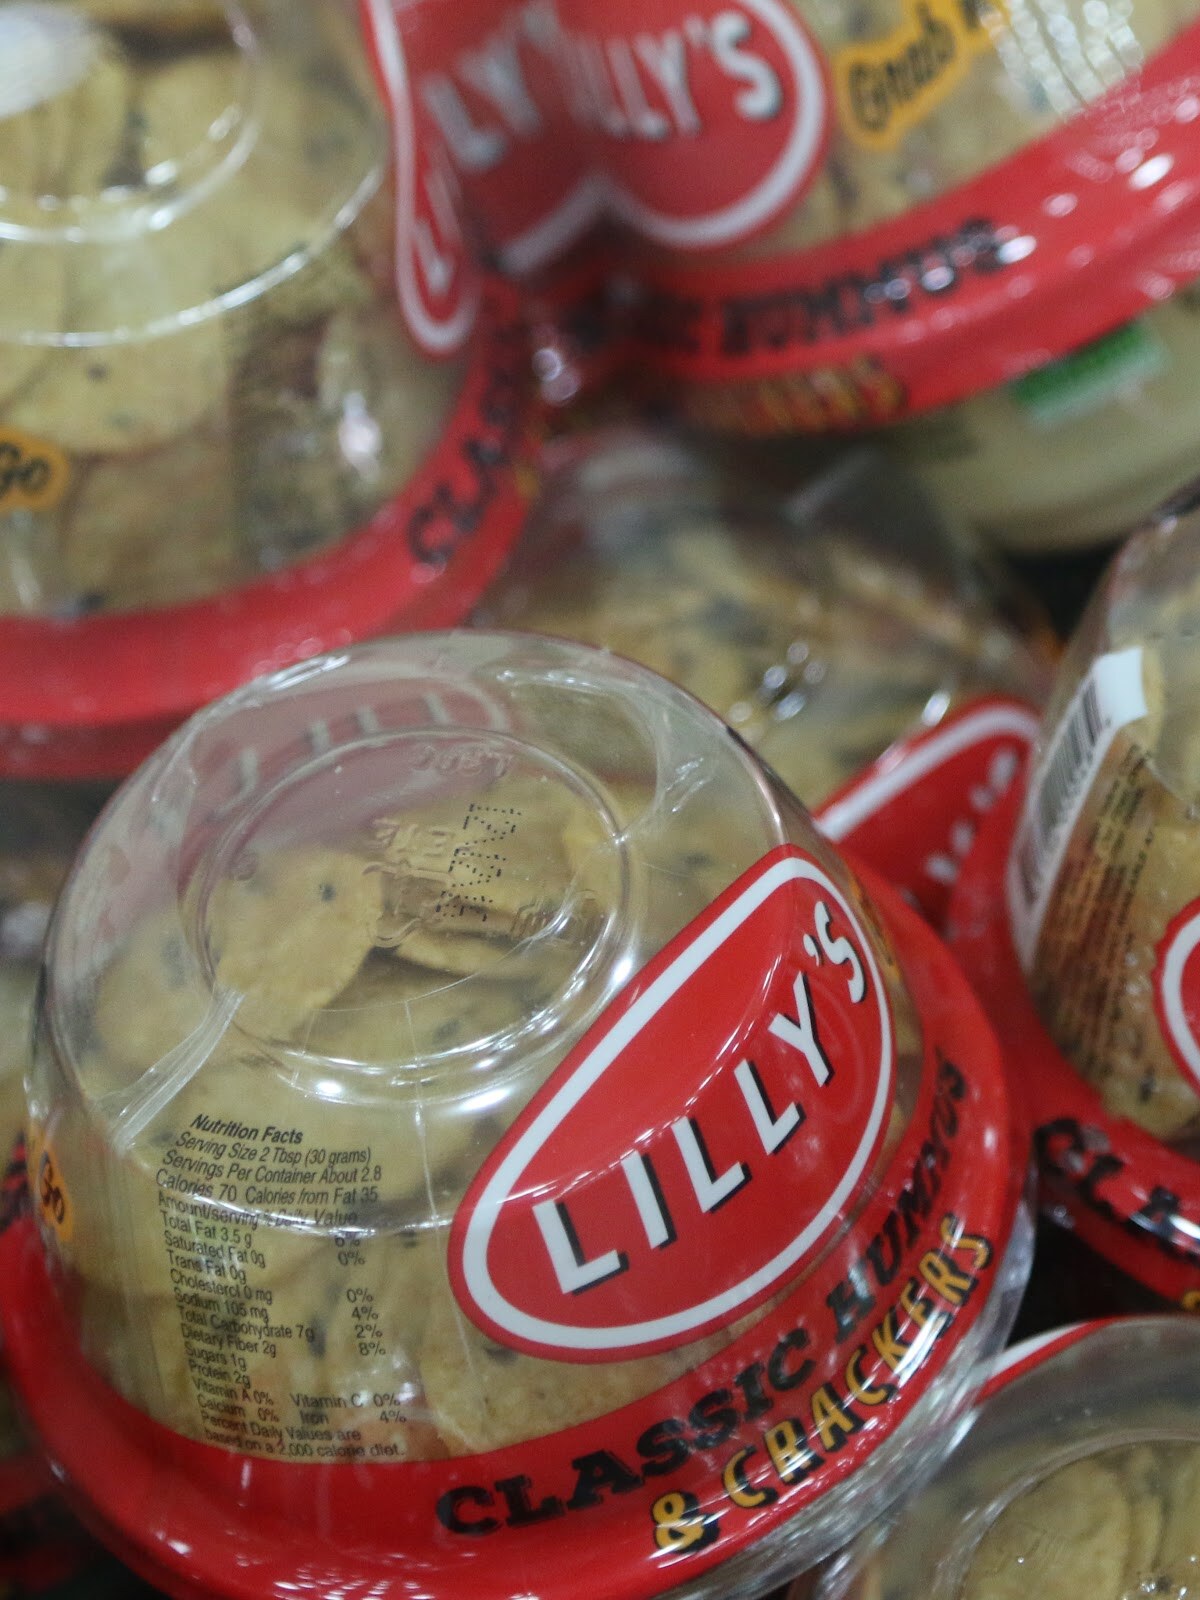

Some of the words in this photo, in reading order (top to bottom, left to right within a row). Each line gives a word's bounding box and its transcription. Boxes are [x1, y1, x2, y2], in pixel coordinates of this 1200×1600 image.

[532, 899, 868, 1297] LILLY'S
[190, 1114, 258, 1140] Nutrition
[262, 1126, 303, 1144] Facts
[176, 1131, 226, 1160] Serving
[228, 1143, 257, 1161] Size
[258, 1149, 270, 1162] 2
[271, 1147, 302, 1168] Tbsp
[304, 1149, 326, 1168] (30
[328, 1147, 372, 1168] grams)
[163, 1150, 223, 1180] Servings
[227, 1163, 253, 1180] Per
[255, 1168, 316, 1184] Container
[318, 1168, 358, 1184] About
[360, 1166, 382, 1182] 2.8
[156, 1168, 213, 1199] Calories
[218, 1183, 237, 1202] 70
[245, 1186, 296, 1205] Calories
[299, 1187, 330, 1205] from
[334, 1187, 358, 1205] Fat
[360, 1186, 379, 1202] 35
[158, 1191, 260, 1231] Amount/serving
[314, 1209, 359, 1226] Value
[160, 1210, 191, 1233] Total
[195, 1219, 217, 1239] Fat
[219, 1228, 241, 1245] 3.5
[244, 1232, 253, 1249] g
[163, 1229, 225, 1260] Saturated
[227, 1246, 249, 1265] Fat
[251, 1252, 266, 1269] 0g
[337, 1250, 367, 1267] 0%
[166, 1249, 201, 1274] Trans
[205, 1260, 226, 1277] Fat
[229, 1265, 247, 1285] 0g
[170, 1267, 241, 1299] Cholesterol
[255, 1287, 273, 1306] mg
[346, 1288, 374, 1304] 0%
[436, 1326, 819, 1536] CLASSIC
[826, 1047, 967, 1344] HUMMUS
[173, 1285, 221, 1312] Sodium
[224, 1298, 248, 1317] 105
[249, 1305, 271, 1326] mg
[179, 1304, 207, 1326] Total
[209, 1314, 293, 1340] Carbohydrate
[351, 1305, 379, 1321] 4%
[181, 1322, 225, 1349] Dietary
[226, 1334, 259, 1353] Fiber
[262, 1341, 277, 1359] 2g
[354, 1323, 384, 1339] 2%
[184, 1340, 228, 1366] Sugars
[230, 1354, 248, 1372] 1g
[358, 1341, 387, 1357] 8%
[188, 1358, 232, 1383] Protein
[233, 1371, 251, 1390] 2g
[651, 1489, 721, 1555] &
[722, 1212, 995, 1509] CRACKERS
[192, 1376, 238, 1400] Vitamin
[240, 1388, 250, 1401] A
[252, 1391, 275, 1407] 0%
[197, 1394, 246, 1419] Calcium
[256, 1406, 280, 1423] 0%
[289, 1392, 348, 1408] Vitamin
[351, 1393, 365, 1408] C
[372, 1392, 402, 1408] 0%
[201, 1411, 248, 1434] Percent
[250, 1422, 283, 1442] Daily
[285, 1425, 334, 1441] Values
[337, 1429, 362, 1441] are
[300, 1409, 330, 1425] Iron
[379, 1409, 408, 1423] 4%
